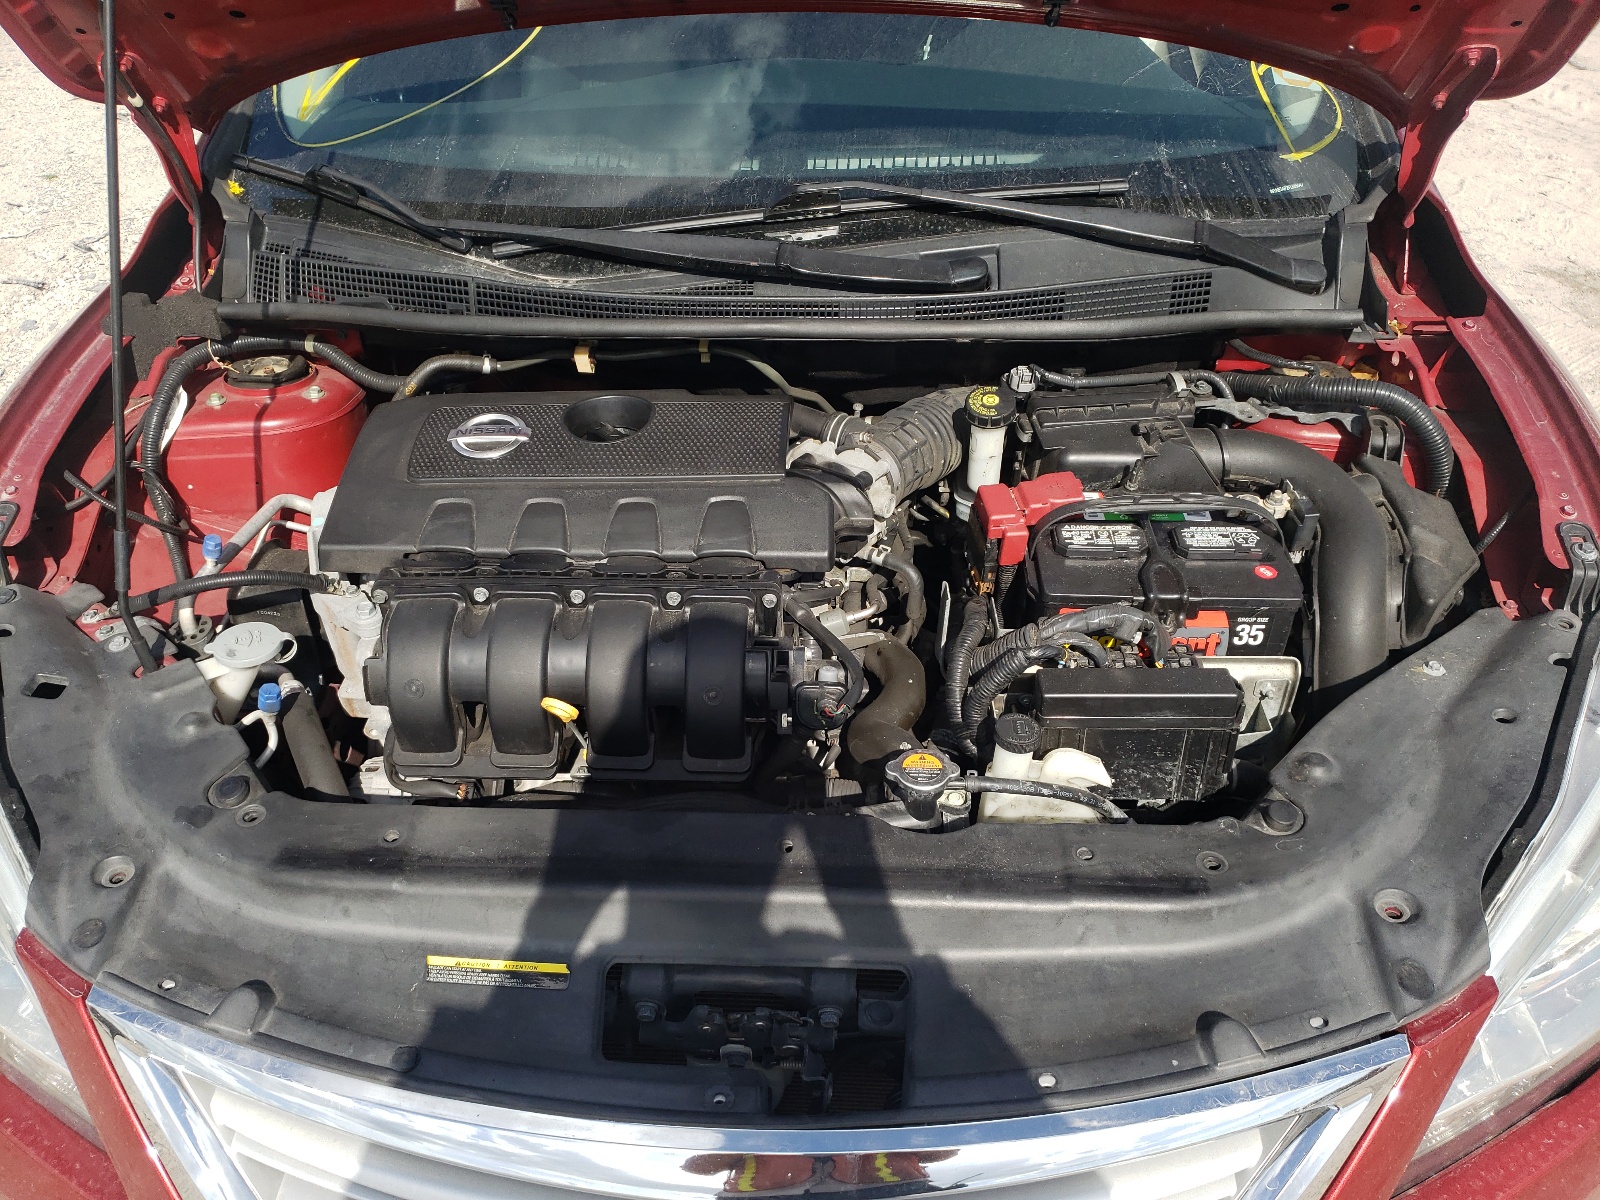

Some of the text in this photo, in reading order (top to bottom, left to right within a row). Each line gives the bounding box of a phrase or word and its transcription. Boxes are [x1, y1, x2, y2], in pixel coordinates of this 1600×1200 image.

[456, 426, 521, 436] NISSAN
[1233, 623, 1266, 646] 35
[503, 963, 539, 971] ATTENTION
